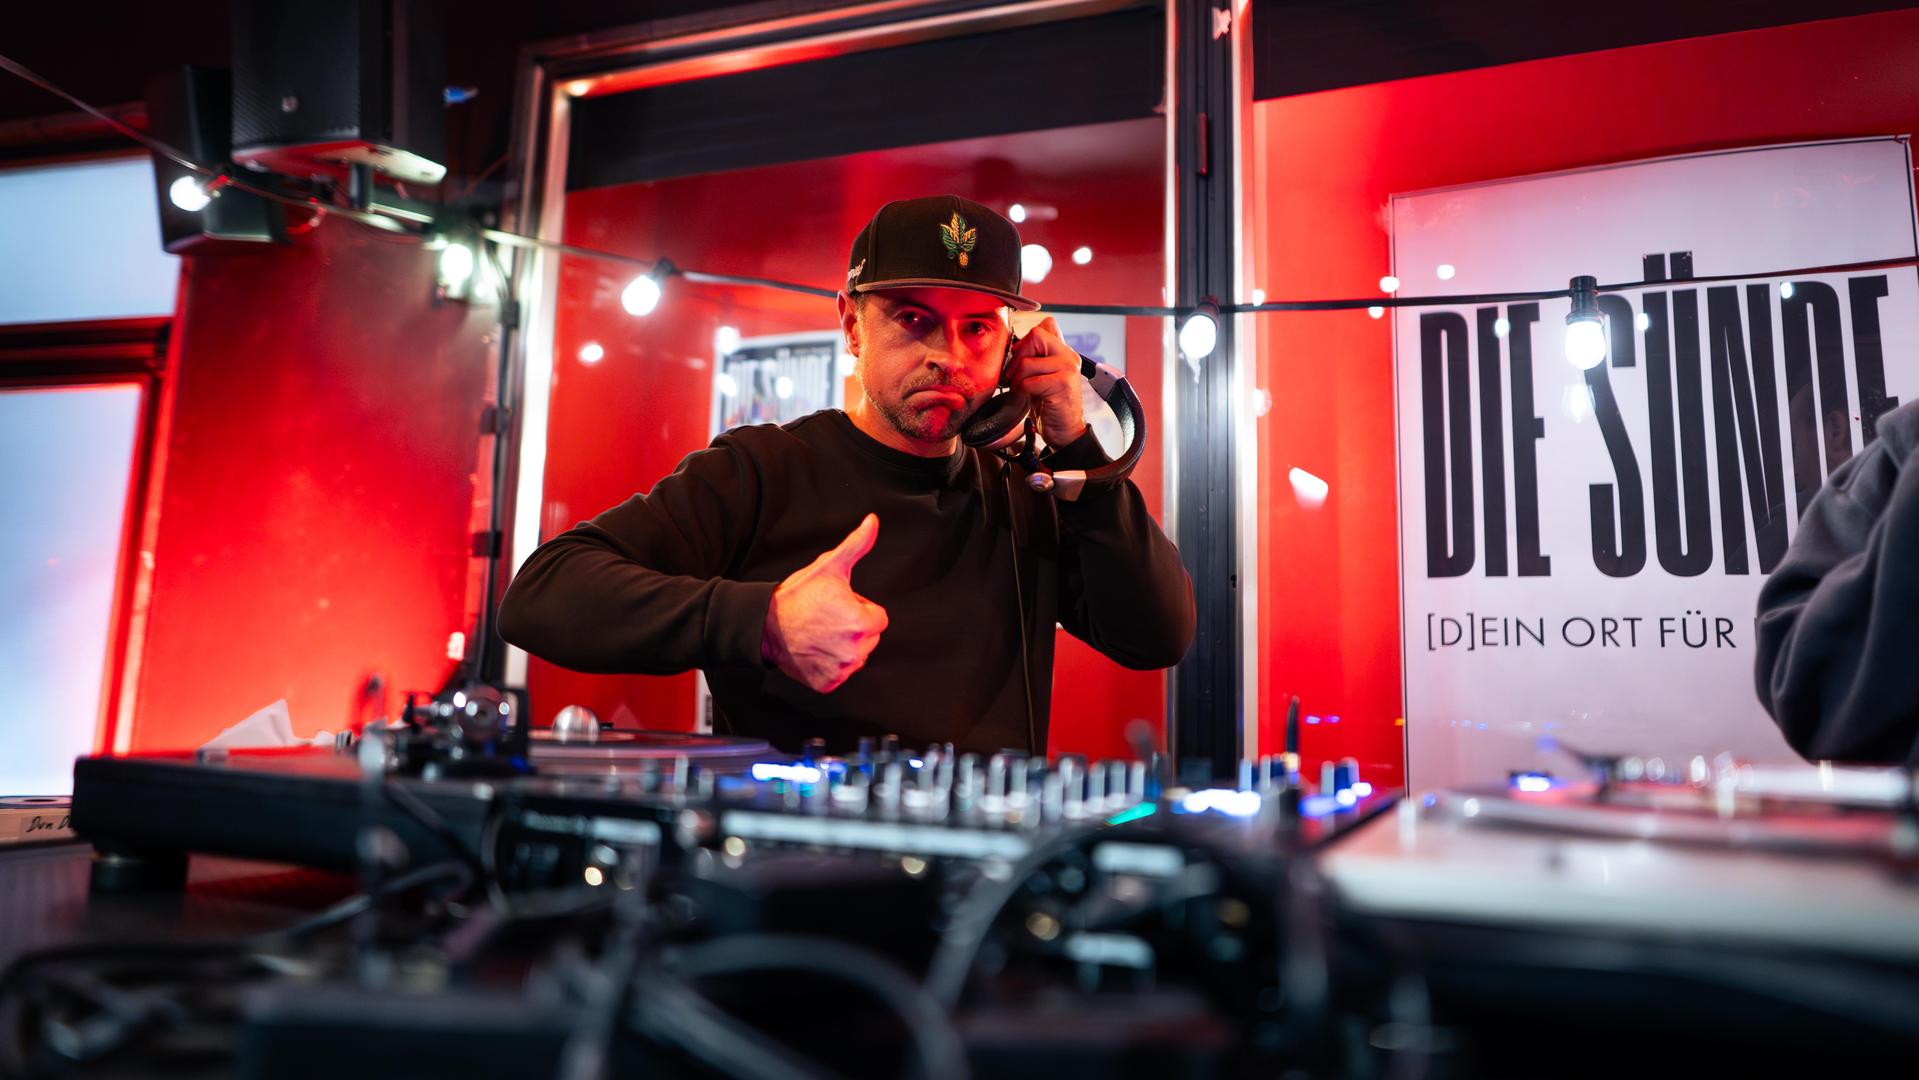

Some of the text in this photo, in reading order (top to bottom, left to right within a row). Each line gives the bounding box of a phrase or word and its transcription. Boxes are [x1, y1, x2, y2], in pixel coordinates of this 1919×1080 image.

[1420, 302, 1551, 578] DIE
[1428, 613, 1545, 651] [D]EIN
[1561, 617, 1643, 647] ORT
[1659, 610, 1737, 649] FÜR
